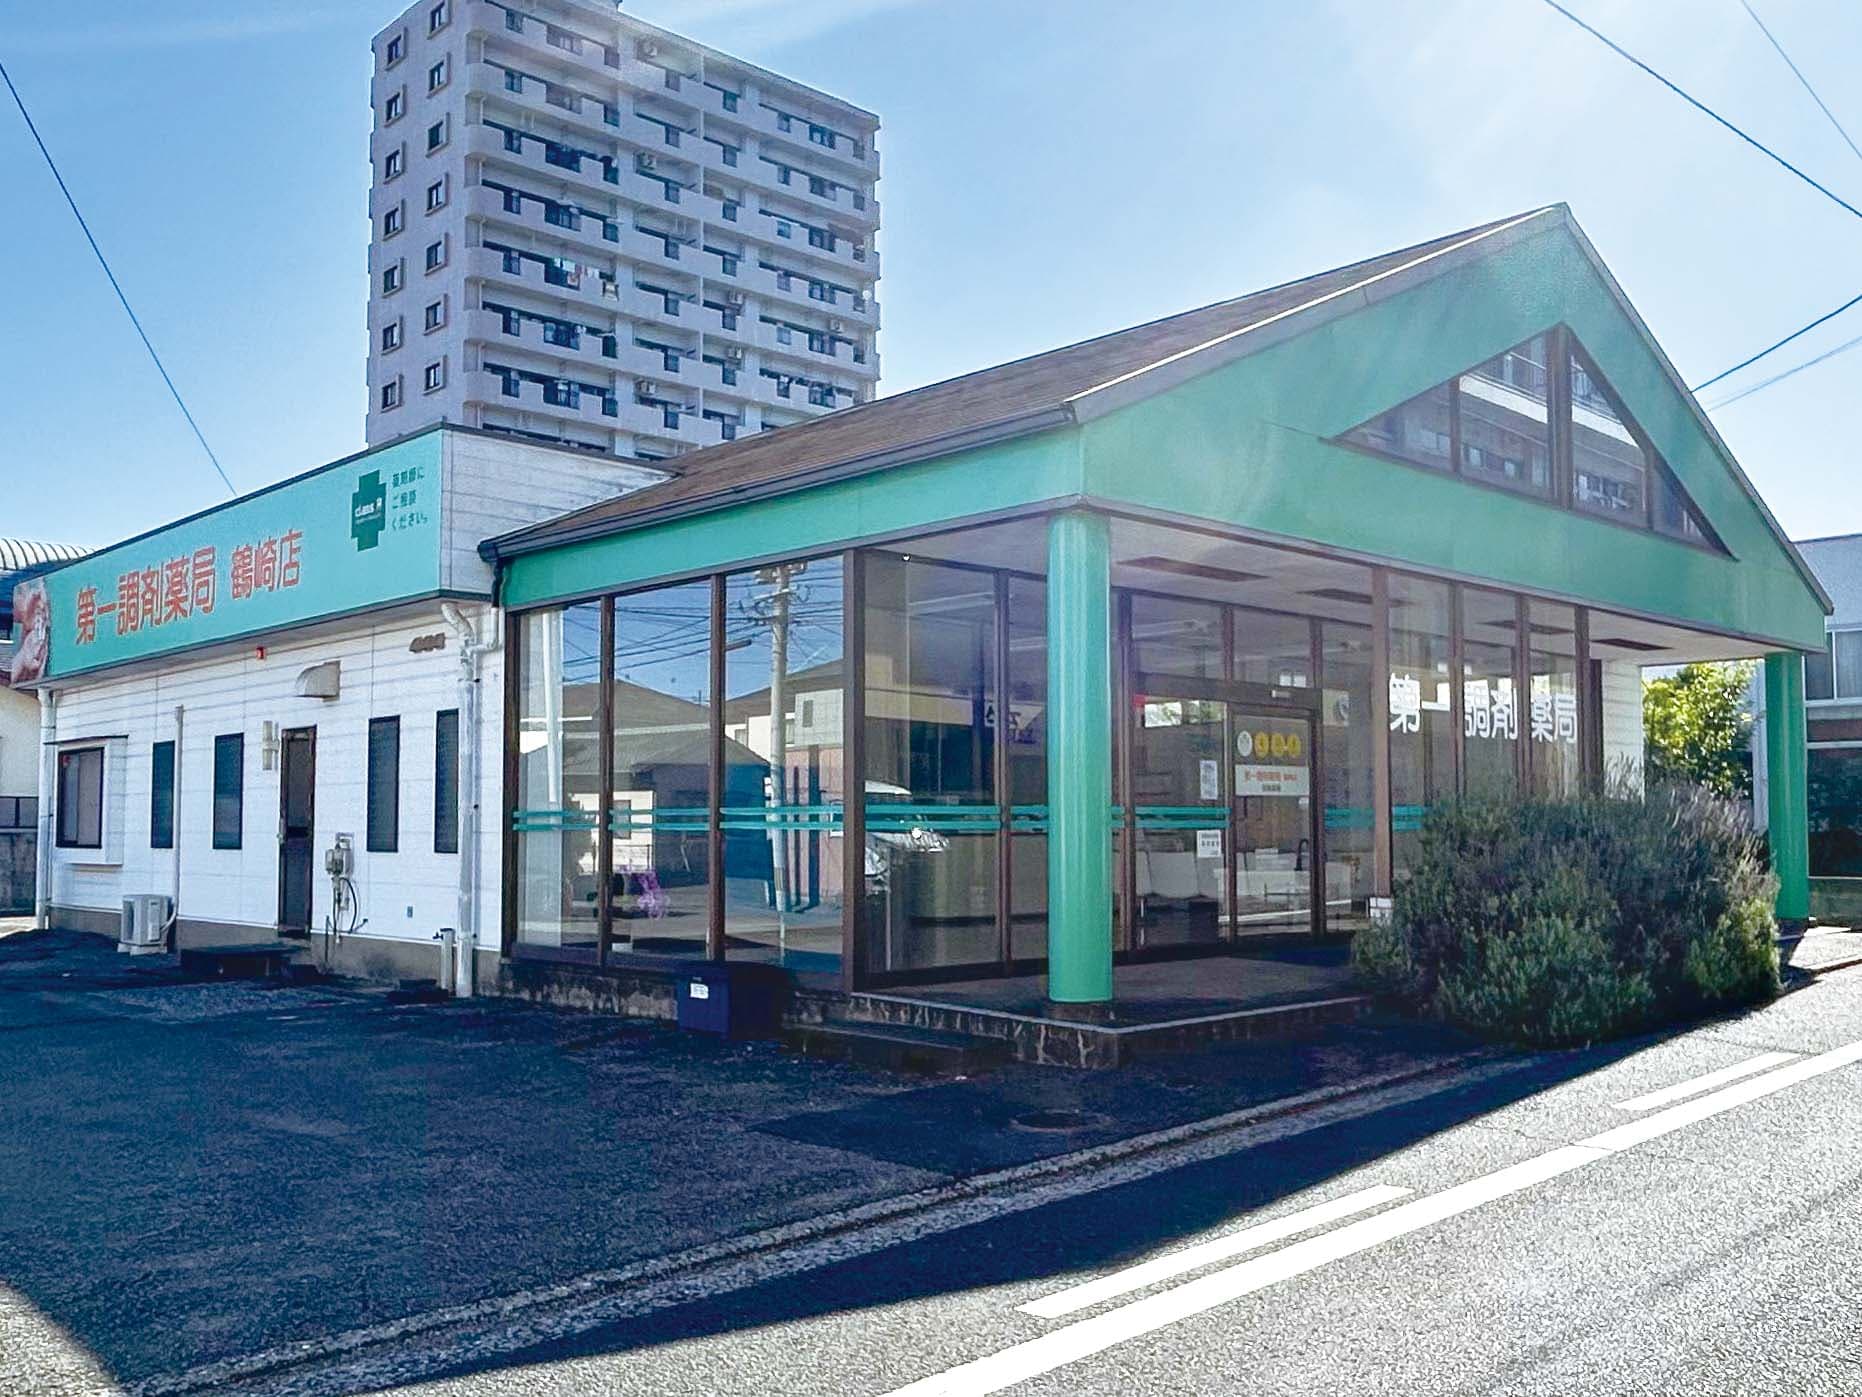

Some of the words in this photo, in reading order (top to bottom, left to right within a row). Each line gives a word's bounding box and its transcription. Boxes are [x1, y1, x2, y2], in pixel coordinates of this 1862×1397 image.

[76, 545, 217, 645] 第一調剤薬局
[230, 528, 304, 600] 鶴崎店
[1389, 672, 1578, 744] 第一調剤薬局
